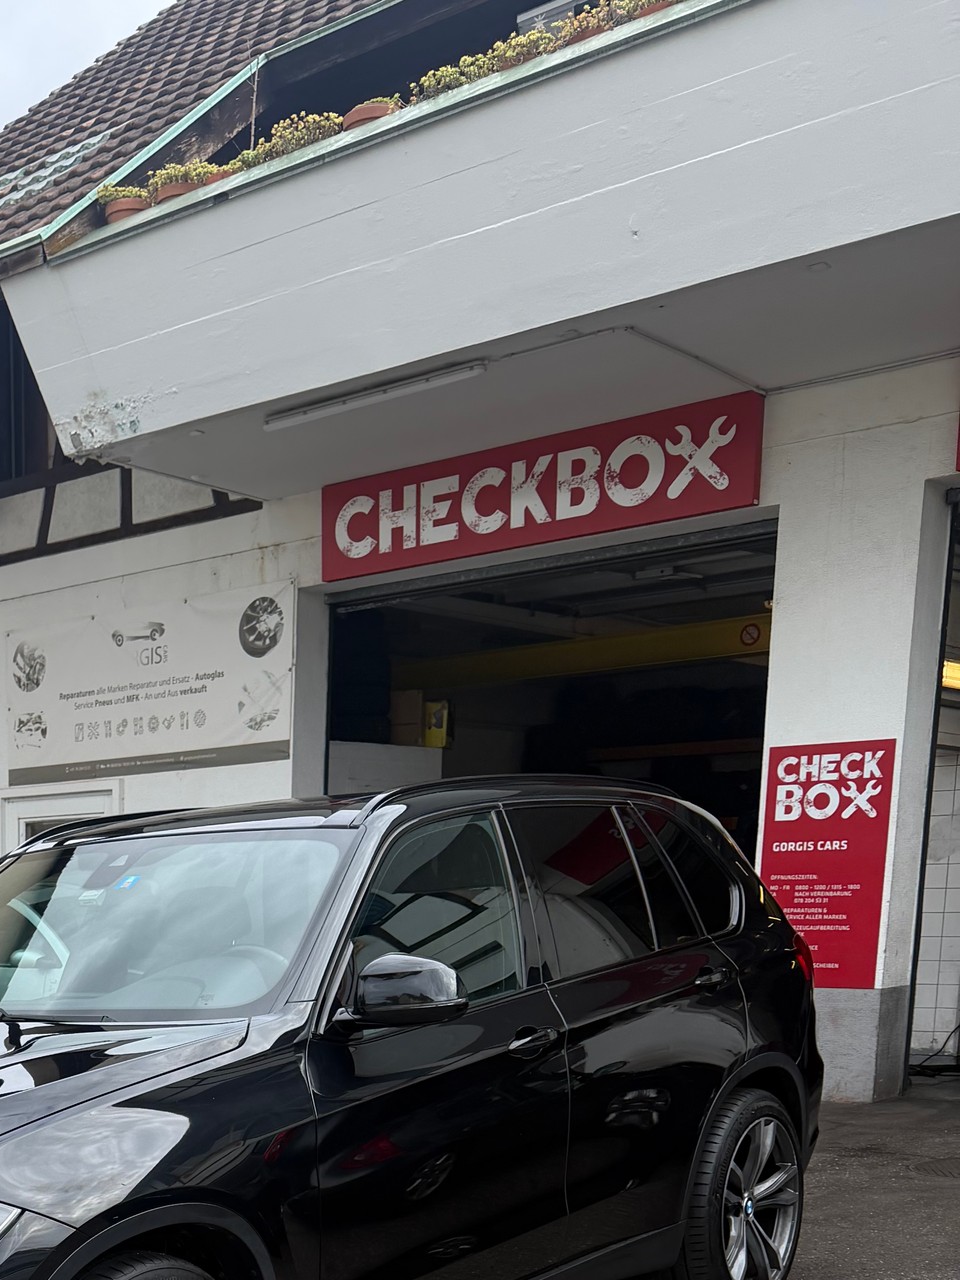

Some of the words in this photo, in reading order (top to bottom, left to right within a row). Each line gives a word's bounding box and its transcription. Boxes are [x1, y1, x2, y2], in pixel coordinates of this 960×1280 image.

[59, 690, 96, 701] Reparaturen
[96, 686, 106, 696] alle
[107, 684, 128, 694] Marken
[128, 680, 158, 692] Reparatur
[158, 676, 171, 686] und
[172, 676, 190, 685] Ersatz
[194, 670, 224, 682] Autoglas
[74, 701, 94, 711] Service
[94, 699, 113, 708] Pneus
[114, 696, 126, 705] und
[126, 693, 140, 703] MFK
[144, 692, 152, 700] An
[154, 690, 166, 700] und
[167, 689, 178, 698] Aus
[179, 684, 207, 696] verkauft
[776, 750, 886, 783] CHECK
[774, 780, 882, 822] BOX
[772, 842, 814, 852] GORGIS
[817, 840, 848, 851] CARS
